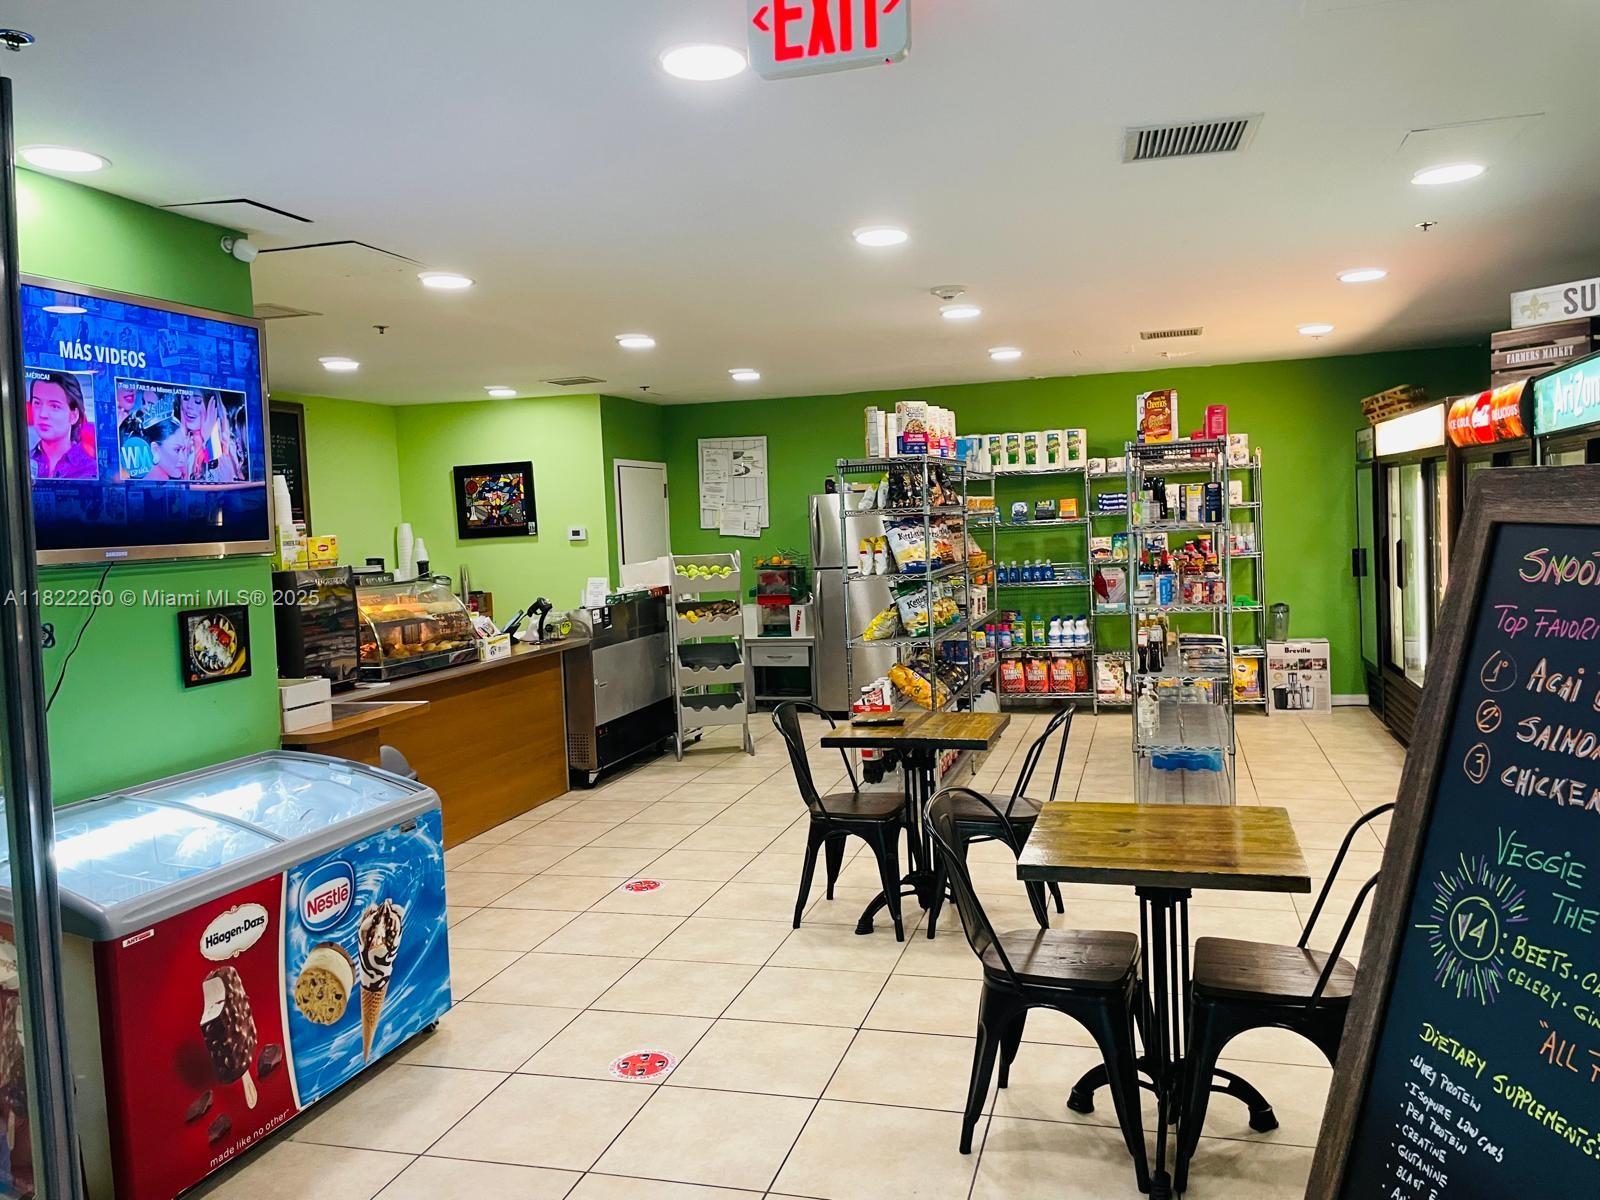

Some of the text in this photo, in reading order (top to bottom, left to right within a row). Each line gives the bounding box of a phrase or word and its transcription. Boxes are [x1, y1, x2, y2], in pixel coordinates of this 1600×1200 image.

[1563, 283, 1600, 315] SU
[59, 339, 147, 368] MÁS VIDEOS
[1506, 345, 1574, 365] FARMERS MARKET
[307, 883, 349, 918] Nestlé
[1457, 912, 1488, 948] V4
[1507, 967, 1561, 1009] CELERY
[210, 1146, 235, 1168] made
[236, 1135, 252, 1150] like
[253, 1127, 264, 1139] no
